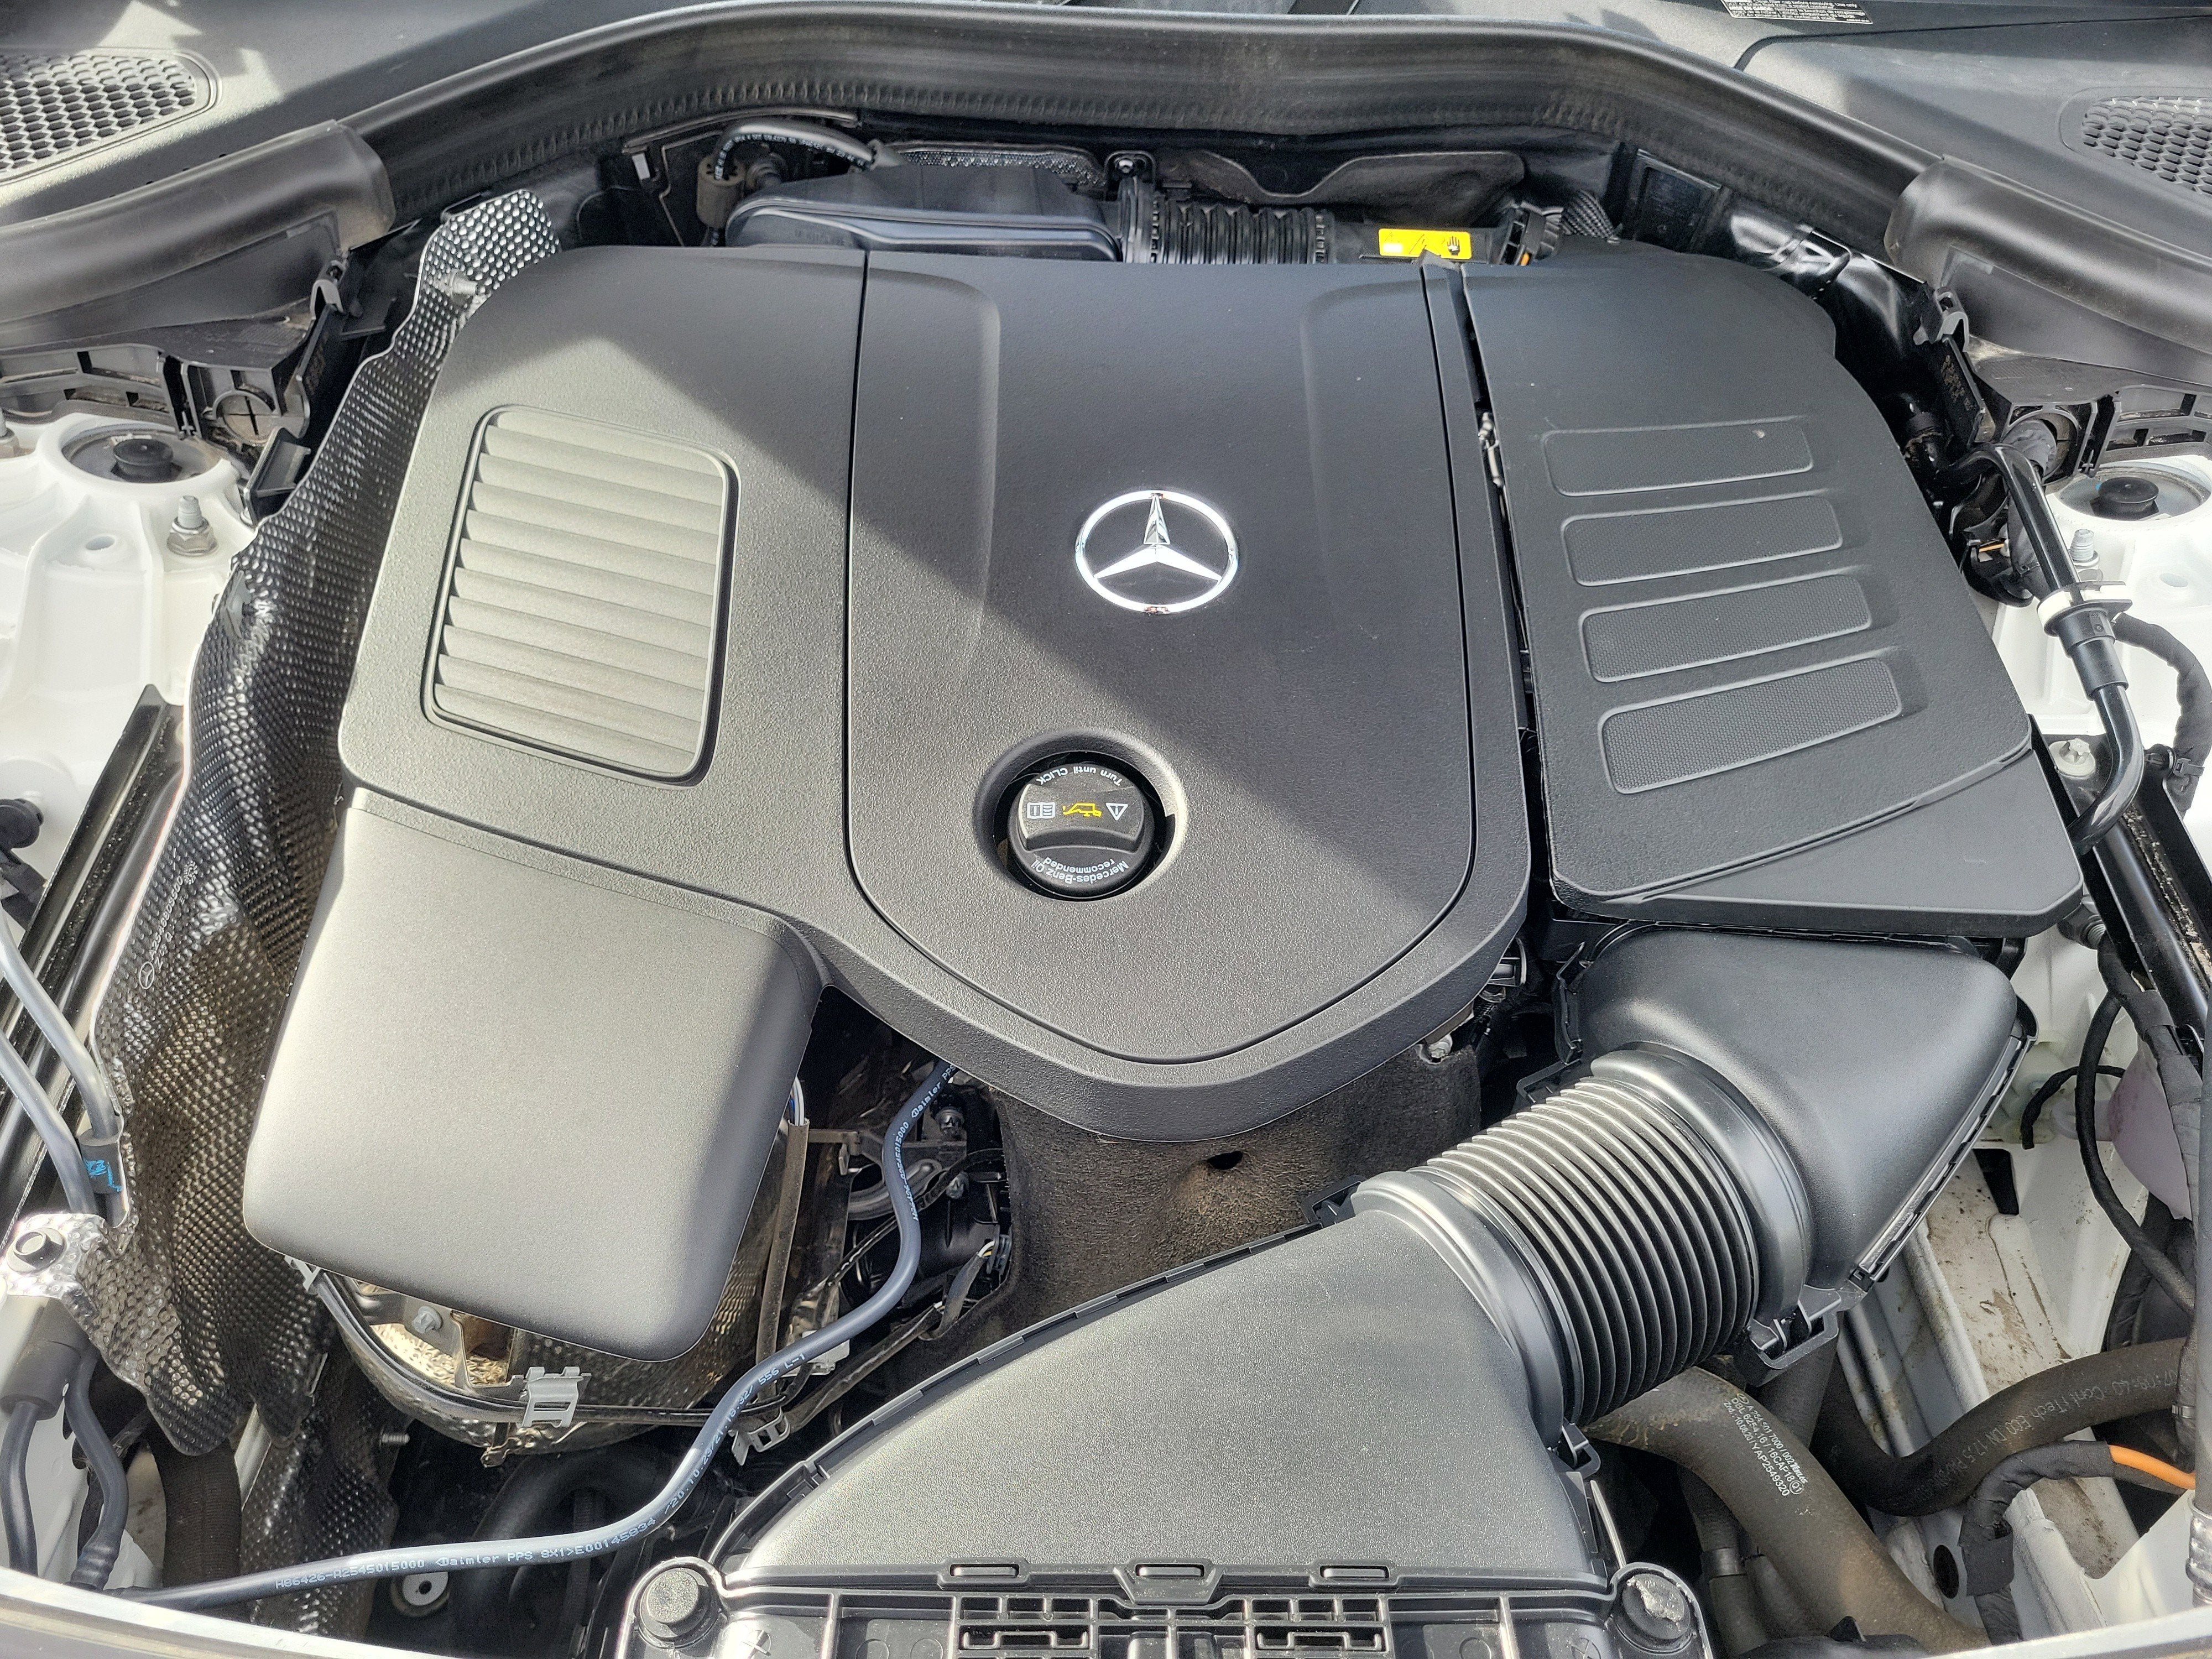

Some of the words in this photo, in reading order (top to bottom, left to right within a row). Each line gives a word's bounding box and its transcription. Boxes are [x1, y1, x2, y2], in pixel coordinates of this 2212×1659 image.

[1036, 767, 1068, 785] CLICK
[1073, 766, 1097, 774] until
[1100, 769, 1123, 787] Turn
[1030, 859, 1045, 873] Oil
[1042, 857, 1116, 874] recommended
[1046, 860, 1130, 884] Mercedes-Benz
[1731, 1397, 1745, 1414] DBL
[507, 1551, 534, 1562] PPS
[758, 1367, 780, 1386] 556
